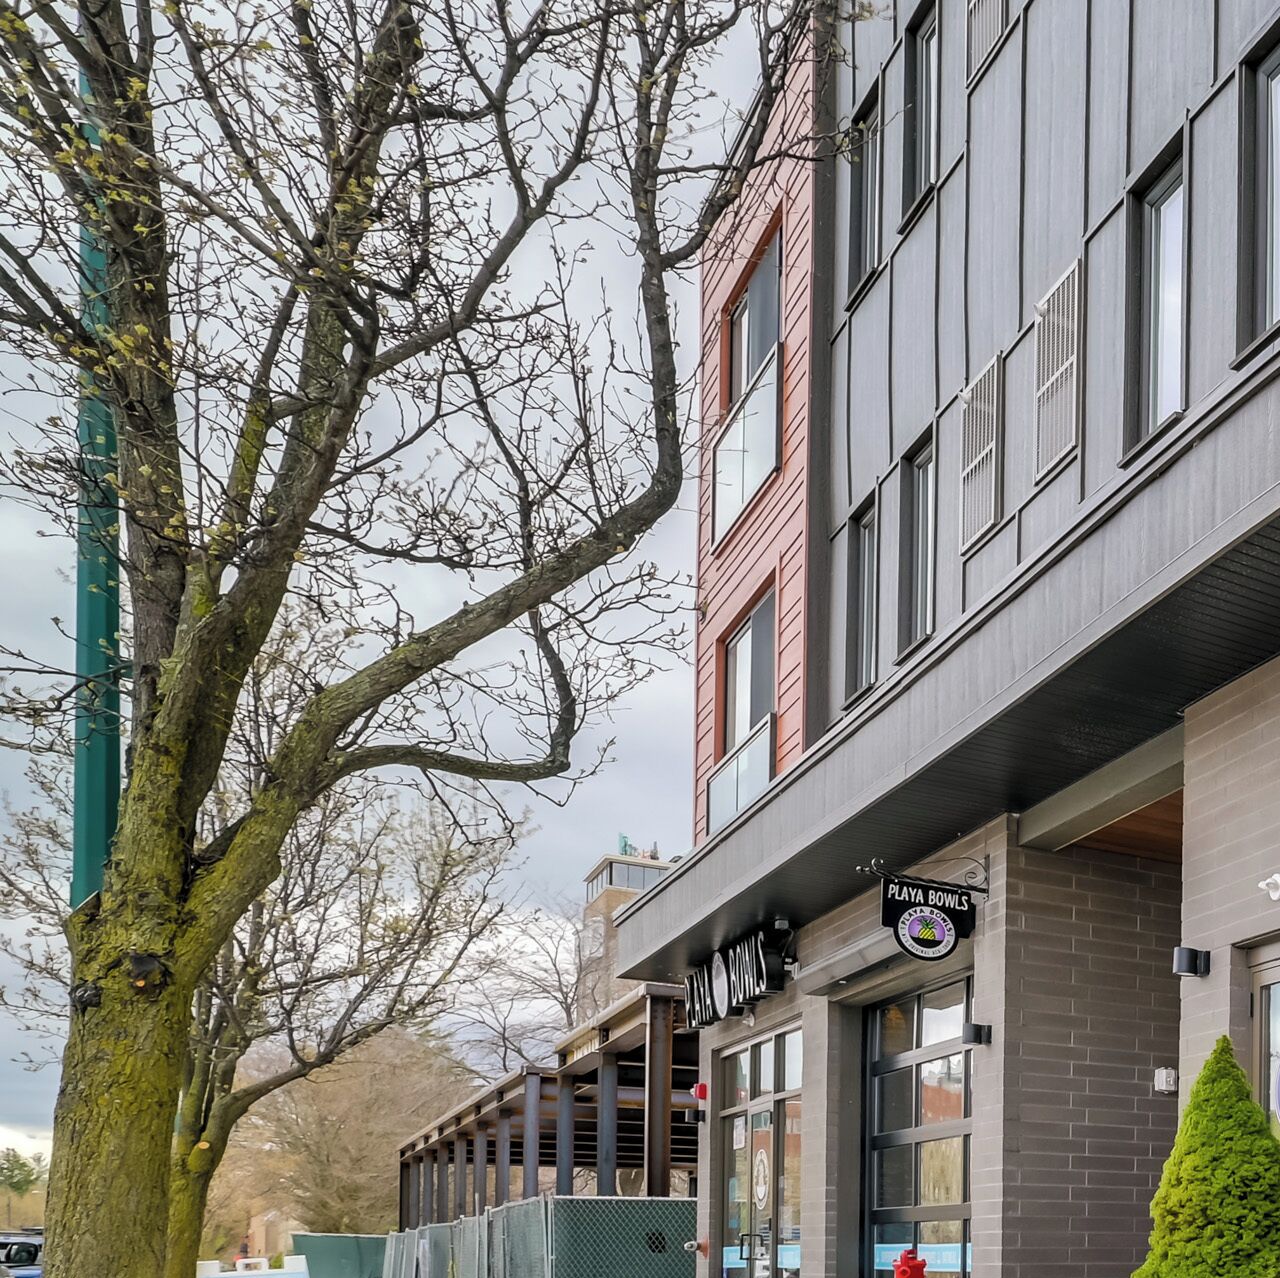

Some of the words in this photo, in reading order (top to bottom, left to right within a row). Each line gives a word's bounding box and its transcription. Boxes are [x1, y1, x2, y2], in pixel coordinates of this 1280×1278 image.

[887, 883, 924, 904] PLAYA
[928, 889, 968, 911] BOWLS
[900, 907, 926, 926] PLAYA
[929, 909, 953, 933] BOWLS
[684, 963, 713, 1029] PLAYA
[728, 931, 767, 1007] BOWLS
